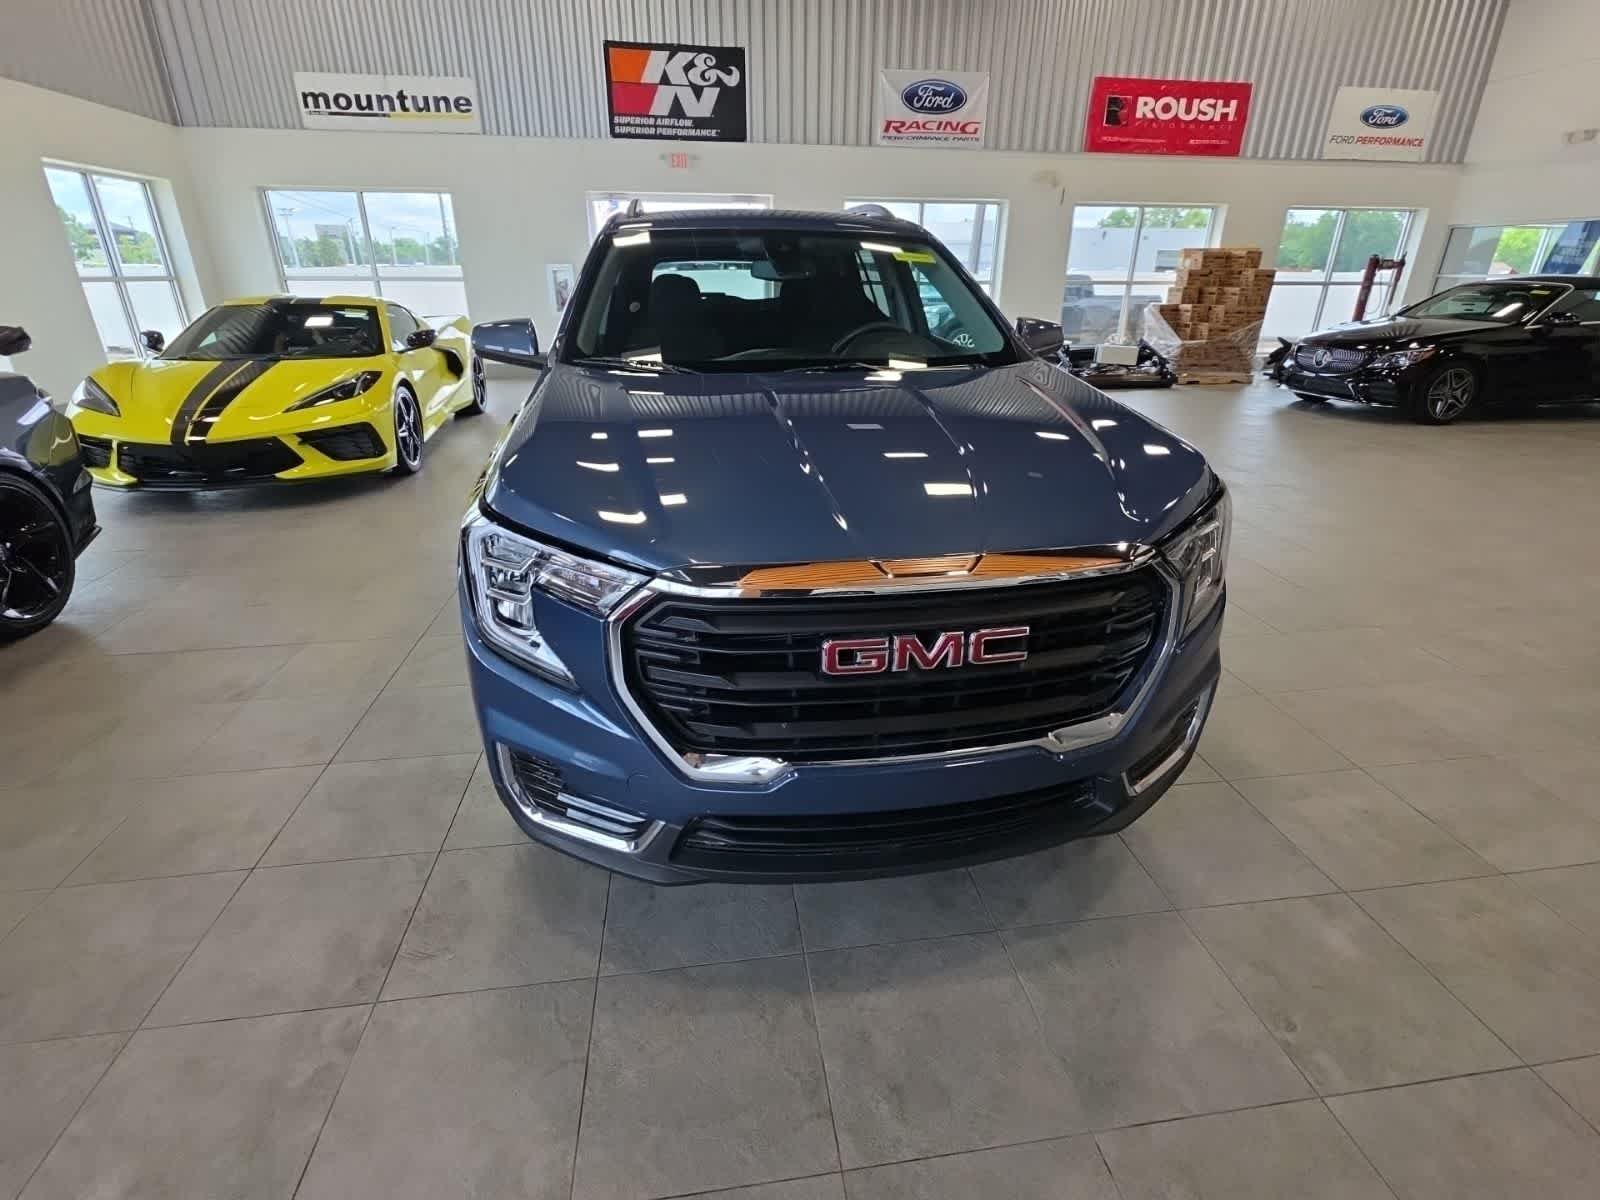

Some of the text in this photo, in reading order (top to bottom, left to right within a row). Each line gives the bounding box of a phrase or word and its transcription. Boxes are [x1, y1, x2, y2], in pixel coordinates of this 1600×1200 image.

[301, 90, 473, 113] mountune
[913, 85, 955, 108] Ford
[1135, 96, 1238, 122] ROUSH
[1368, 108, 1401, 125] Ford
[613, 116, 655, 125] SUPERIOR
[884, 120, 982, 134] RACING
[614, 126, 656, 135] SUPERIOR
[1329, 135, 1424, 147] FORD PERFORMANCE
[822, 626, 1029, 675] GMC
